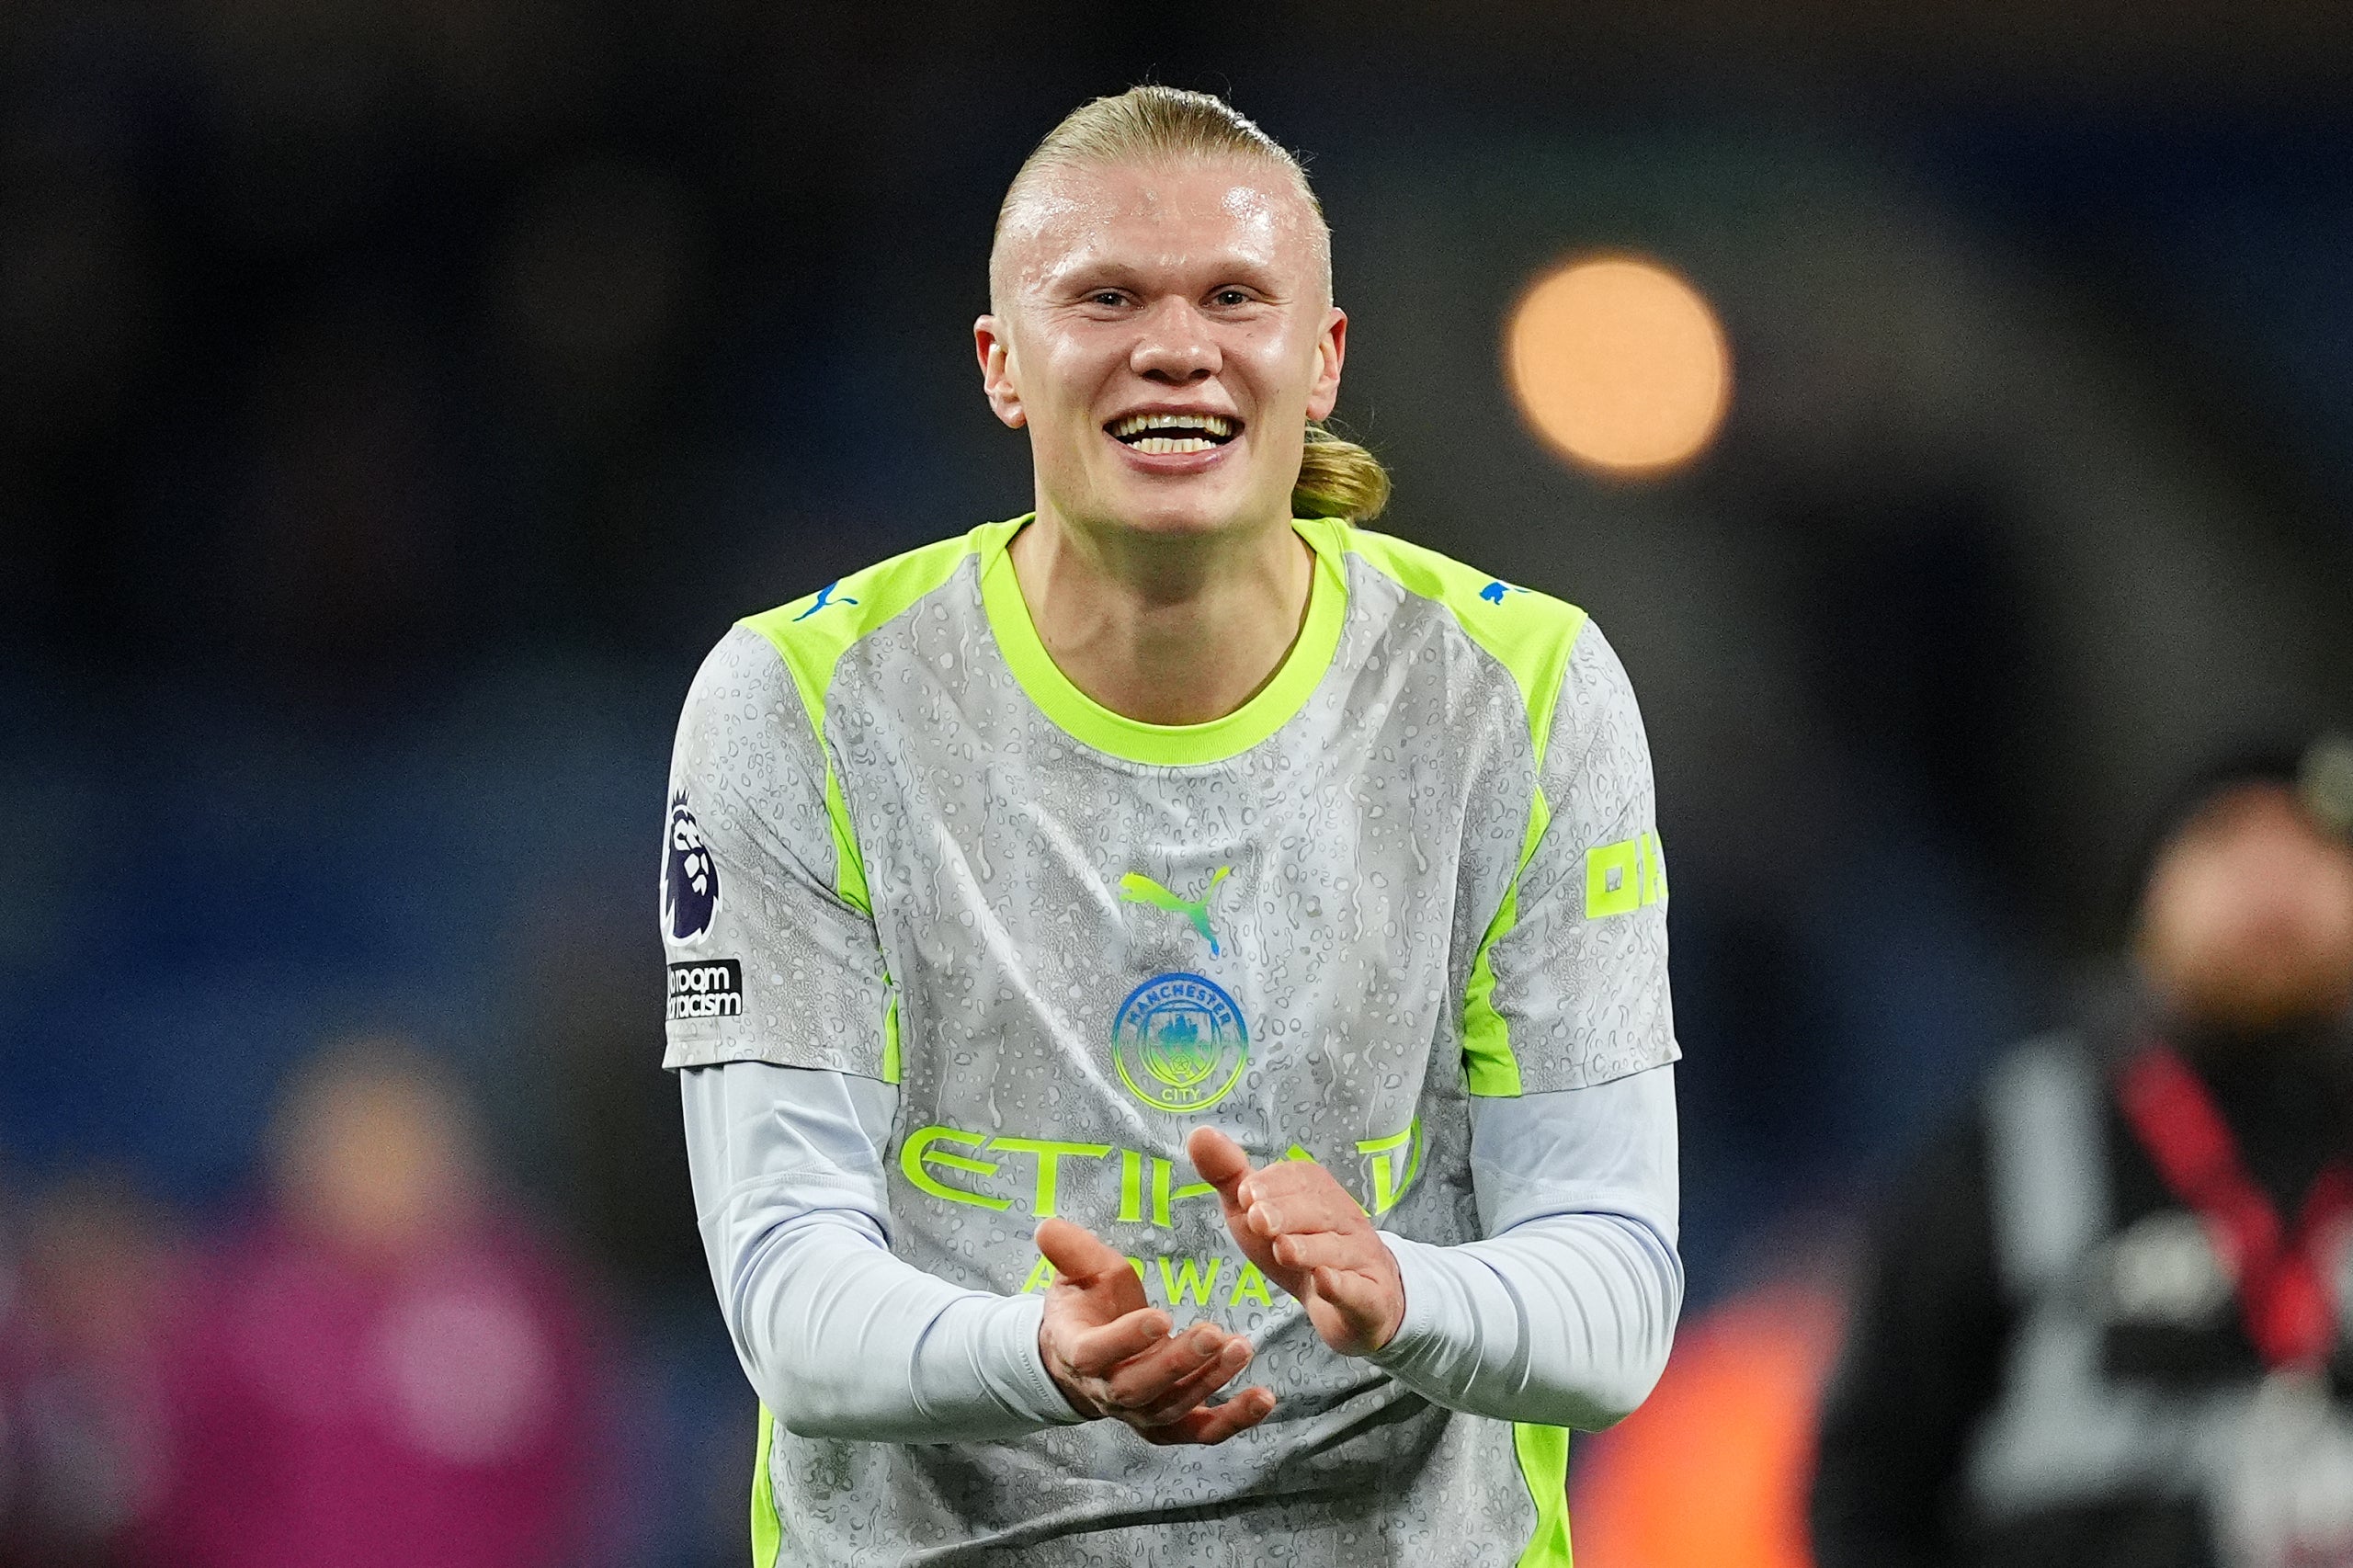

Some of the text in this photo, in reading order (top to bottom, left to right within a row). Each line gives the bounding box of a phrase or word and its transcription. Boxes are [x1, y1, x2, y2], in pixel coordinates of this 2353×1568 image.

[676, 966, 730, 994] room
[676, 991, 742, 1018] racism
[1128, 984, 1232, 1026] MANCHESTER
[1161, 1088, 1202, 1102] CITY
